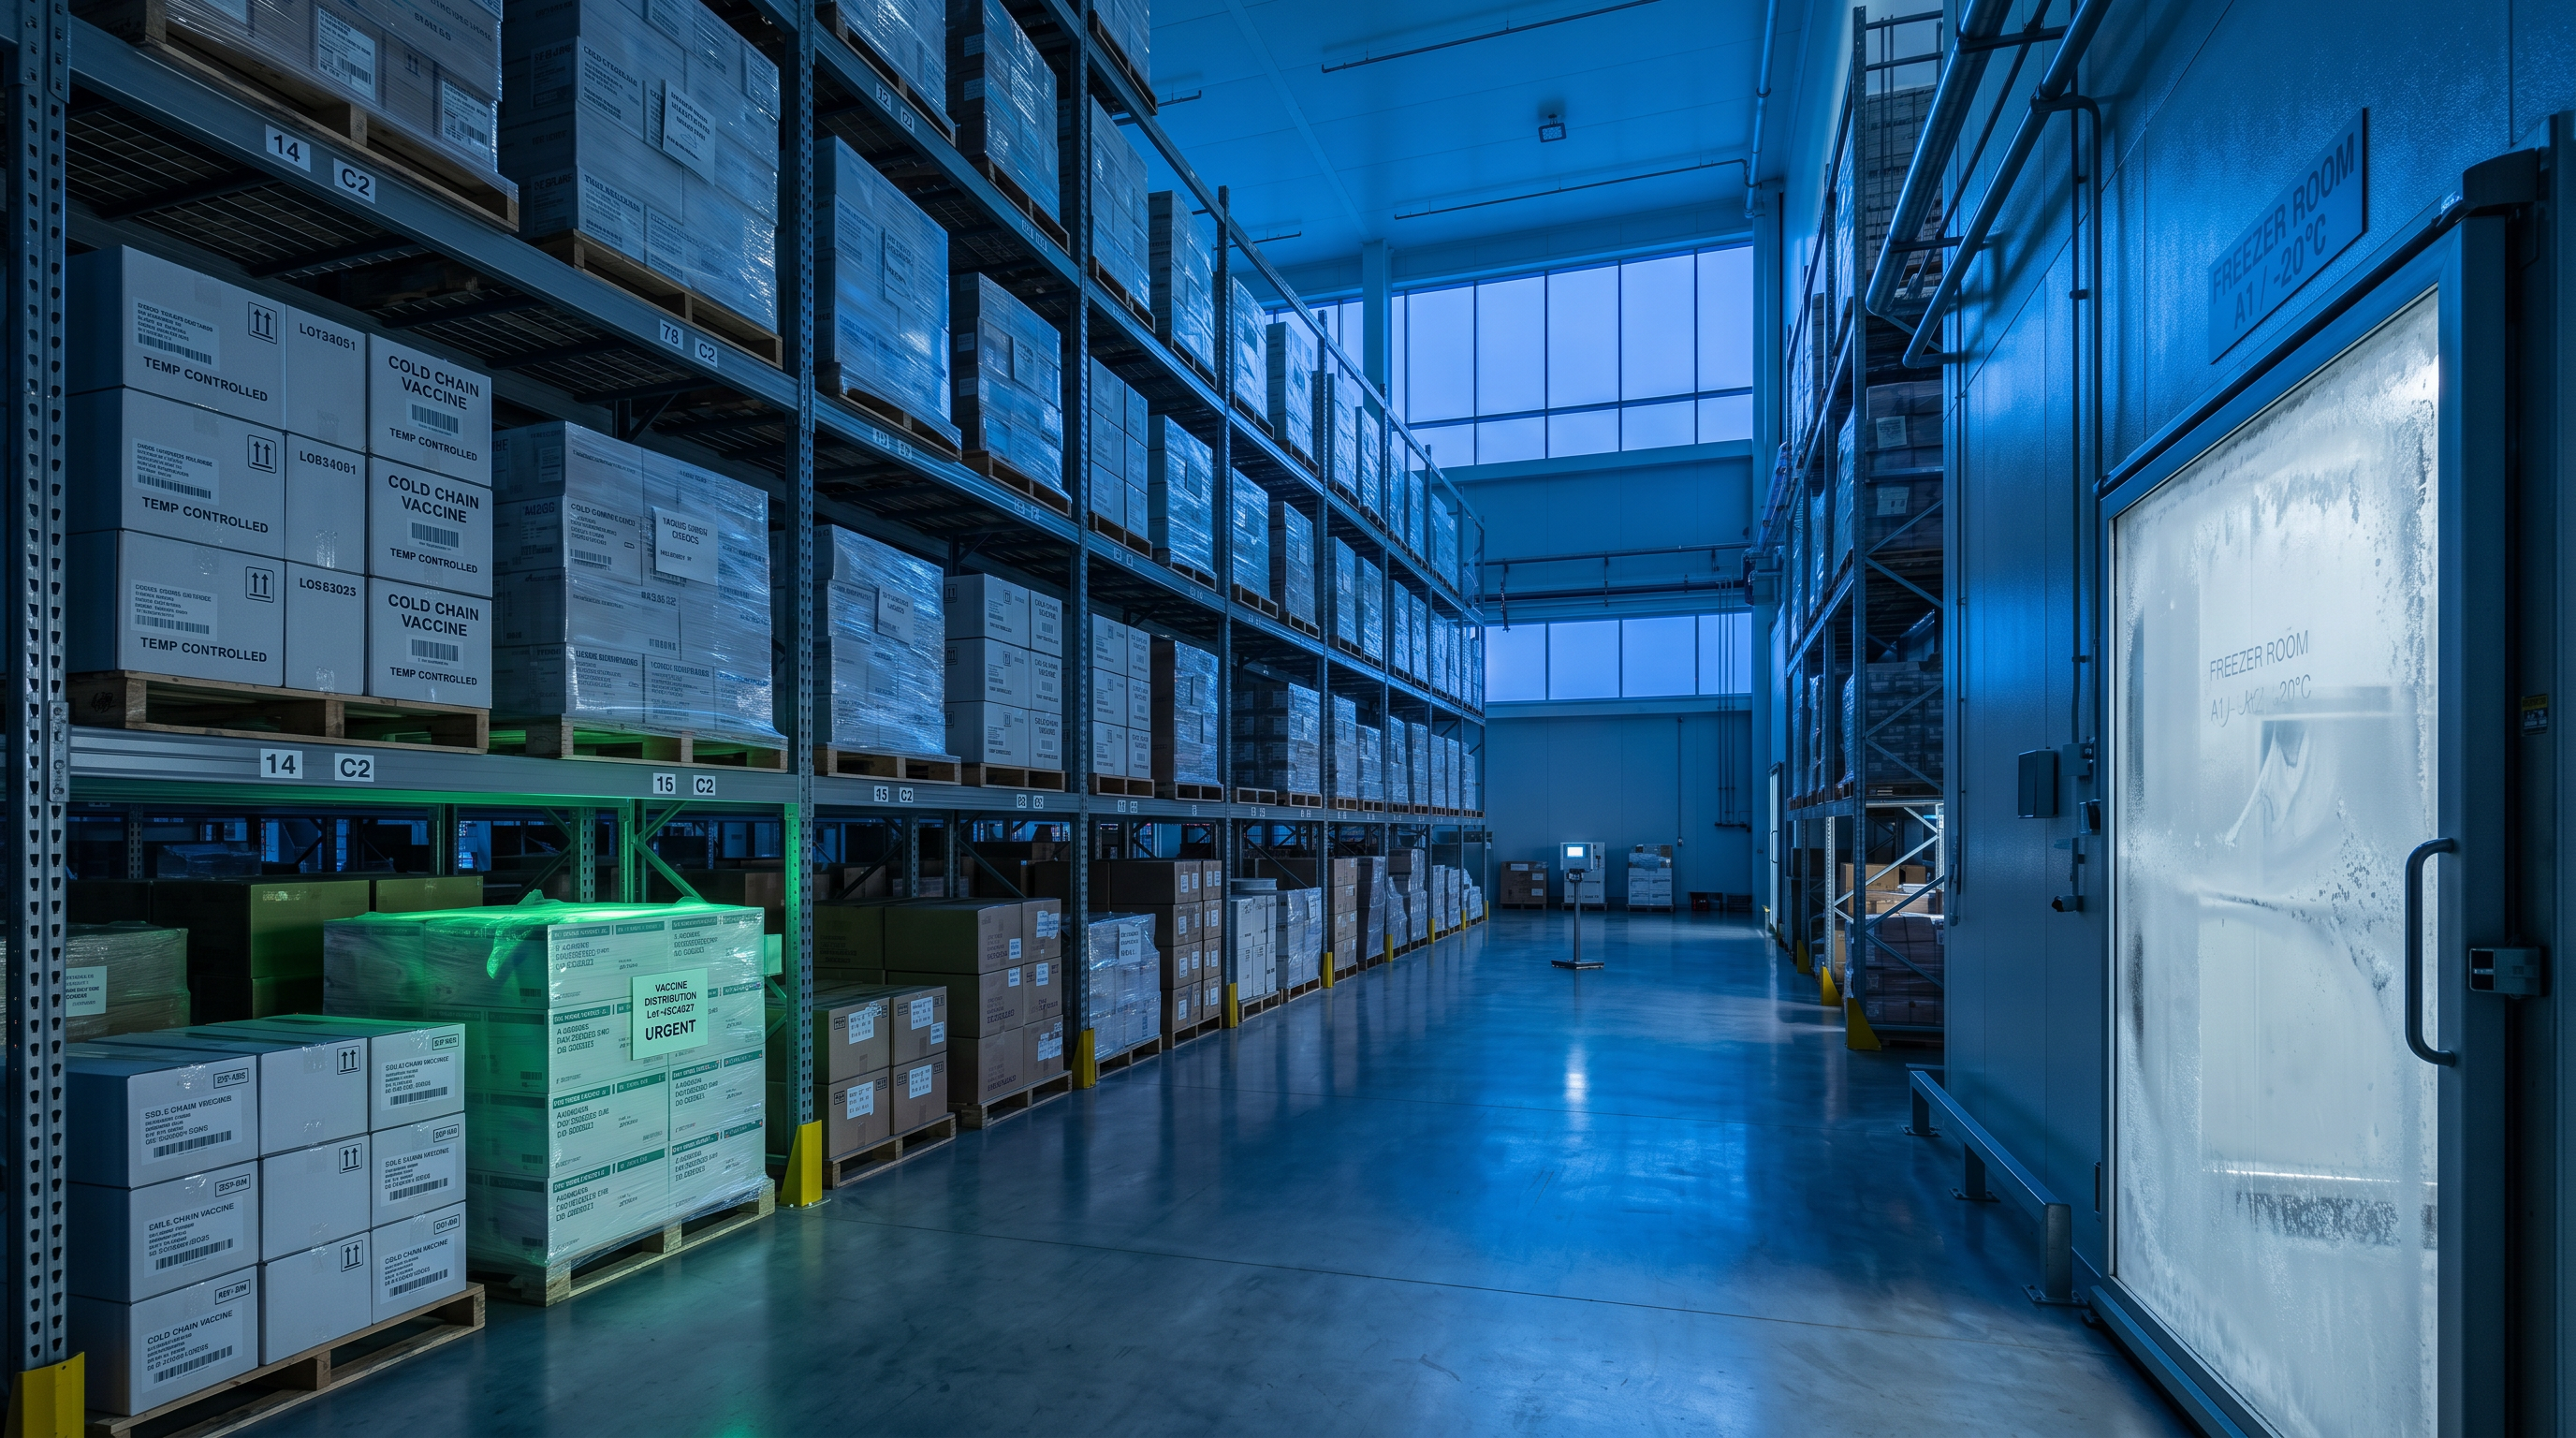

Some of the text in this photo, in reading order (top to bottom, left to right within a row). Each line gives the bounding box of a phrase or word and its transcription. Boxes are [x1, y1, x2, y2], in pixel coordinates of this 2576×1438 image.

[273, 134, 300, 163] 14
[342, 168, 370, 197] C2
[2213, 132, 2354, 305] FREEZER ROOM
[2233, 281, 2254, 330] A1
[662, 323, 679, 345] 78
[699, 343, 715, 363] C2
[143, 356, 268, 402] TEMP CONTROLLED
[388, 356, 479, 398] COLD CHAIN
[401, 376, 467, 410] VACCINE
[389, 427, 477, 461] TEMP CONTROLLED
[388, 475, 479, 509] COLD CHAIN
[142, 496, 269, 533] TEMP CONTROLLED
[401, 495, 467, 523] VACCINE
[389, 548, 477, 573] TEMP CONTROLLED
[388, 594, 479, 621] COLD CHAIN
[401, 613, 467, 637] VACCINE
[140, 637, 267, 662] TEMP CONTROLLED
[2210, 630, 2308, 682] FREEZER ROOM
[389, 667, 416, 678] TEMP
[266, 754, 296, 774] 14
[340, 757, 371, 778] C2
[657, 776, 673, 792] 15
[695, 778, 713, 793] C2
[901, 790, 912, 801] C2
[645, 991, 696, 1006] DISTRIBUTION
[655, 980, 688, 992] VACCINE
[645, 1019, 696, 1041] URGENT
[200, 1202, 235, 1217] VACCINE
[173, 1320, 198, 1336] CHAIN
[199, 1309, 233, 1327] VACCINE
